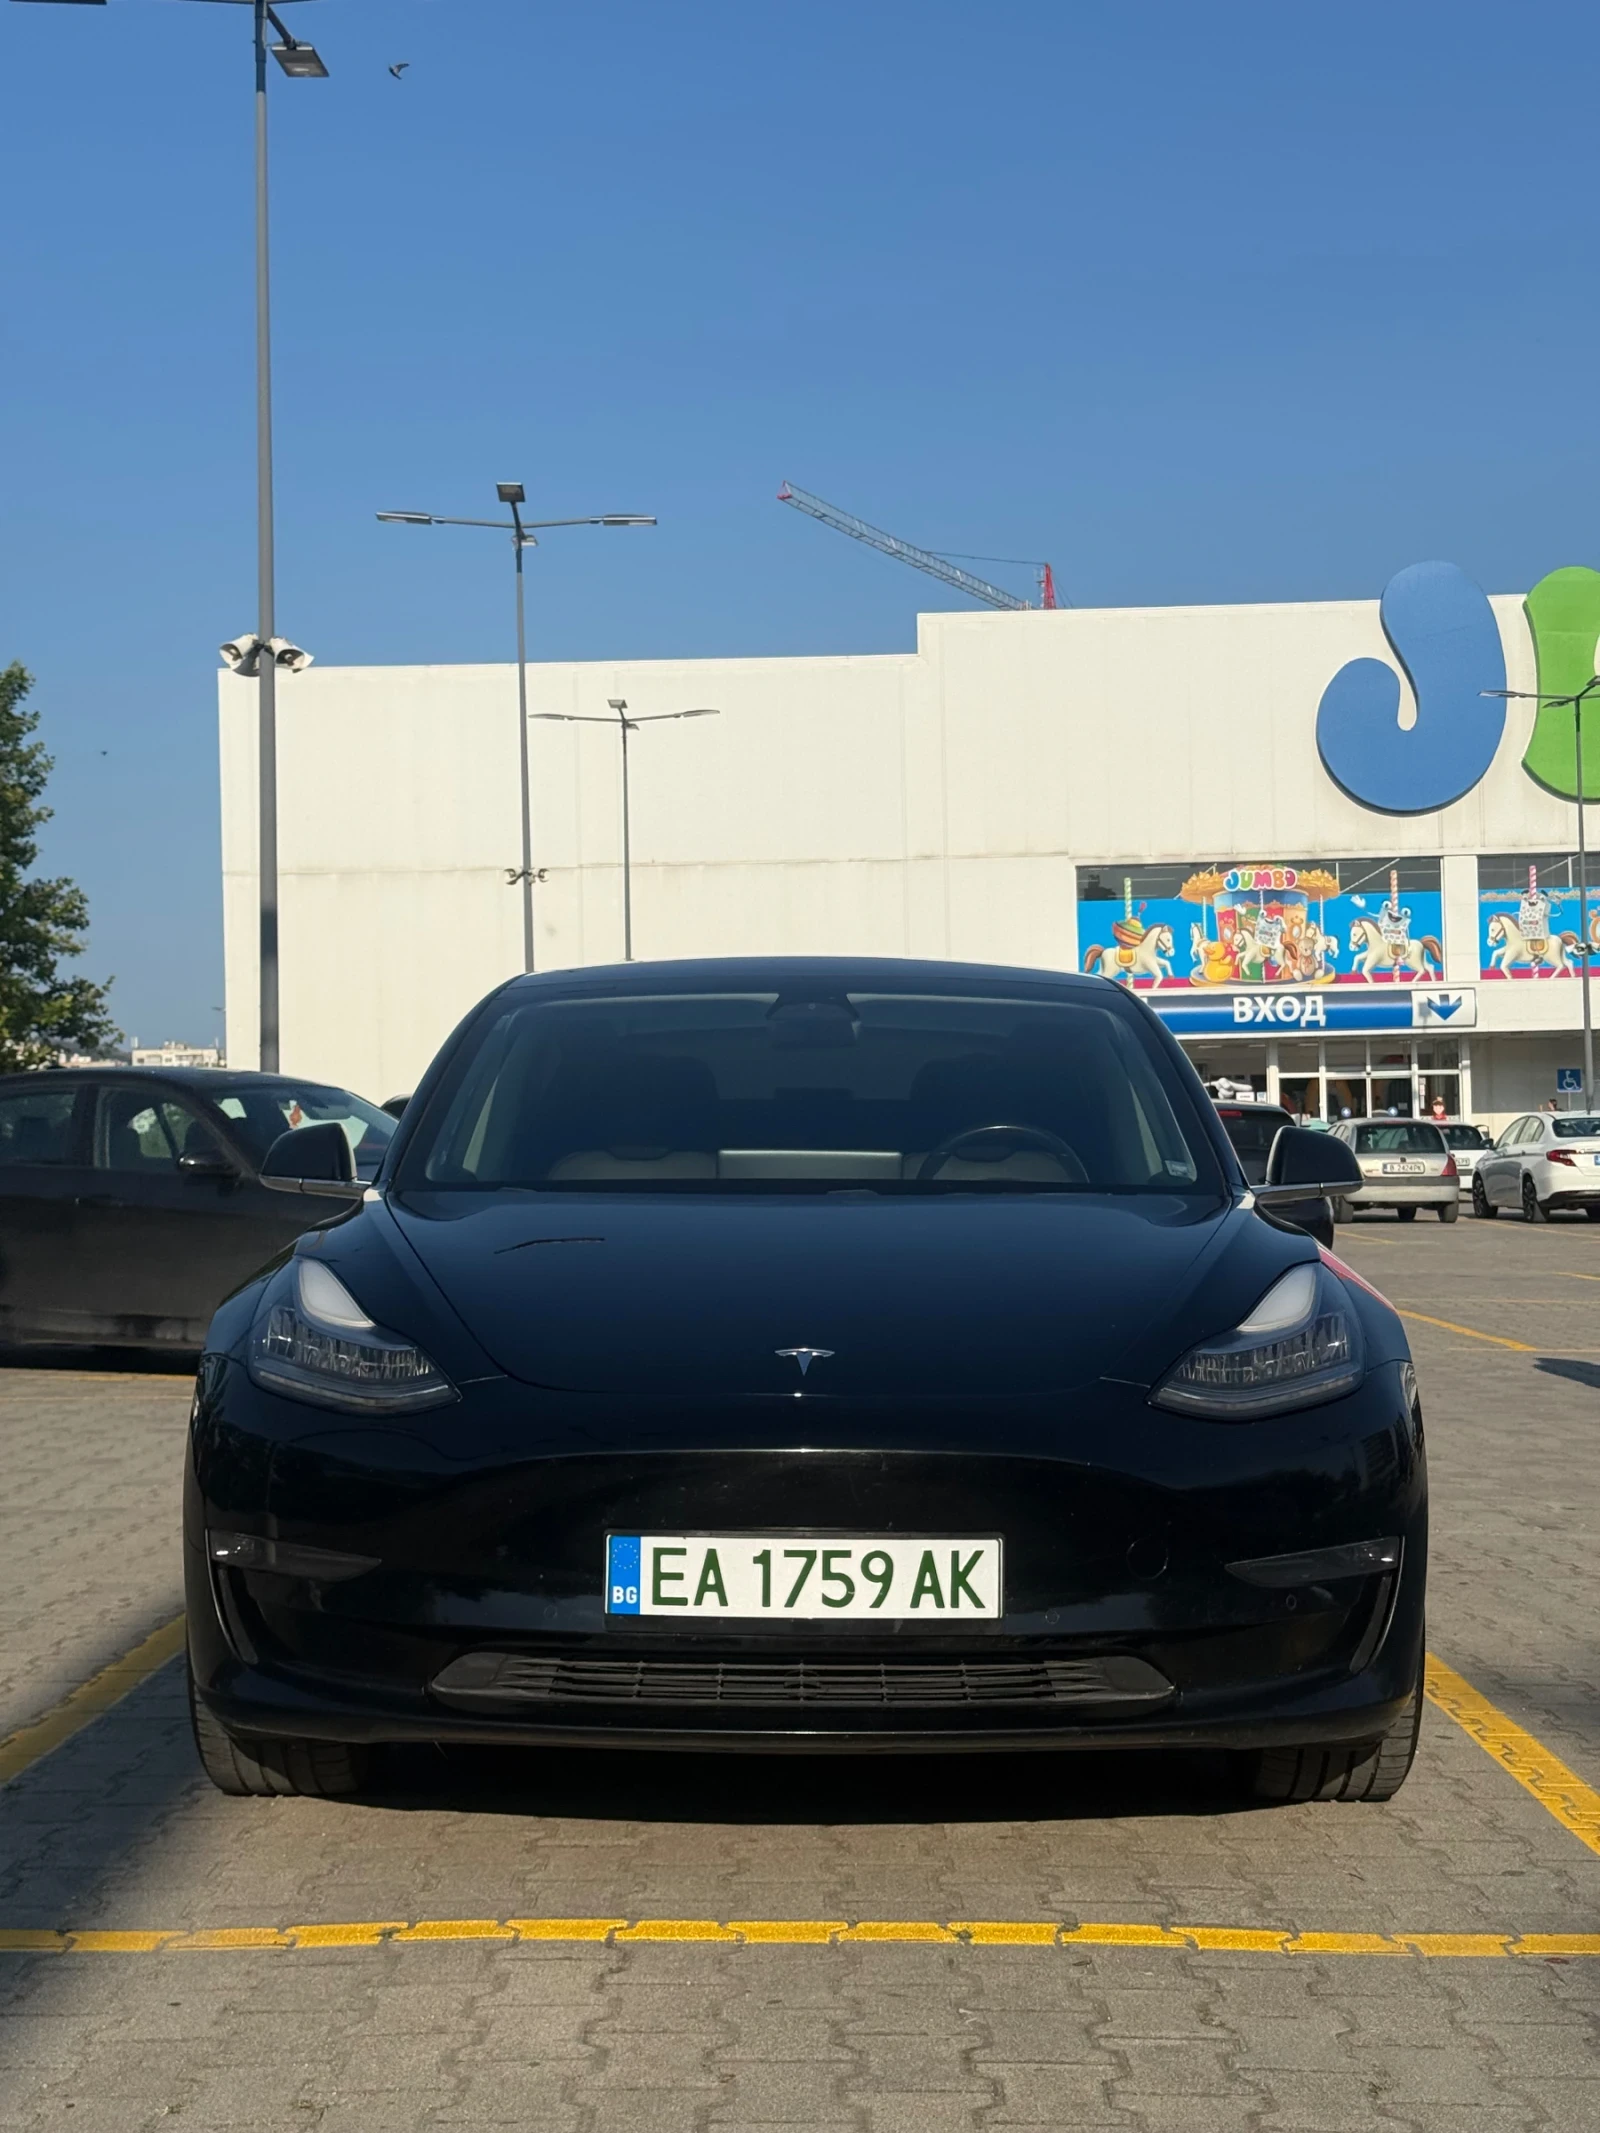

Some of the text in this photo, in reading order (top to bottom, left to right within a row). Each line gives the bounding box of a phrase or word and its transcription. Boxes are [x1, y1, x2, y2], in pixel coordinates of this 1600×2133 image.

[1223, 867, 1298, 892] JUMBO
[1233, 995, 1326, 1027] ВХОД
[652, 1547, 985, 1609] EA 1759 AK
[612, 1585, 637, 1604] BG
